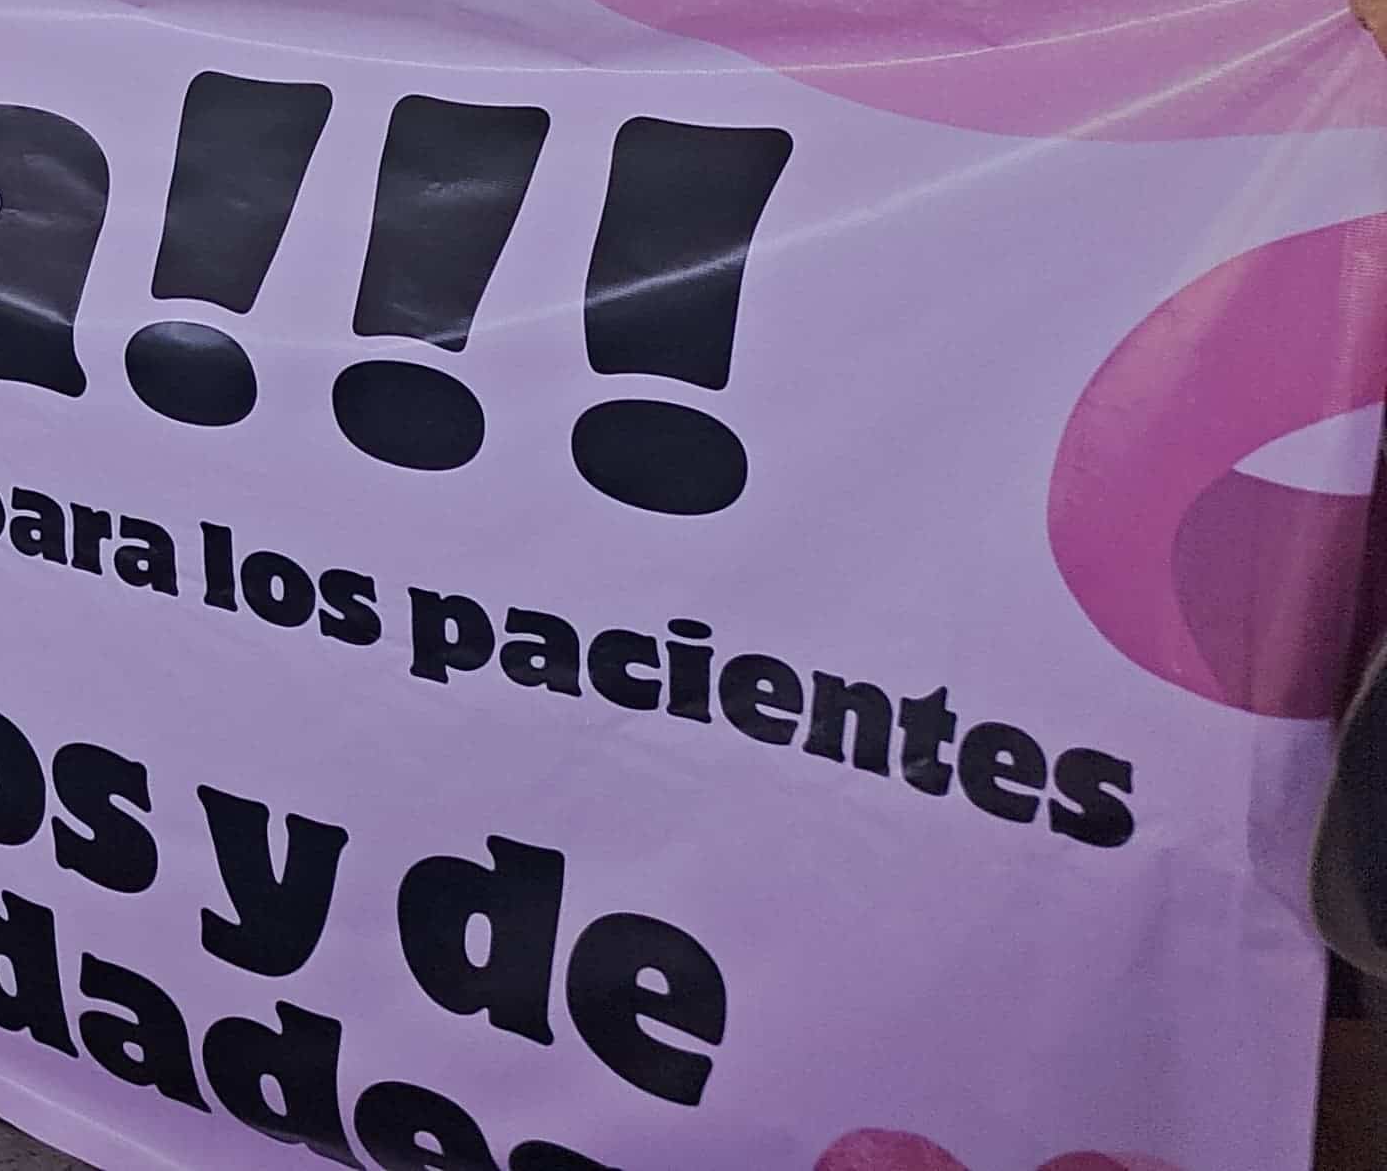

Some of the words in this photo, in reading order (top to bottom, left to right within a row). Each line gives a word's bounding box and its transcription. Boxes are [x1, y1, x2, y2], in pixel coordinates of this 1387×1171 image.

[199, 521, 383, 647] los
[407, 586, 1136, 849] pacientes
[196, 784, 349, 978] y
[397, 835, 729, 1107] de
